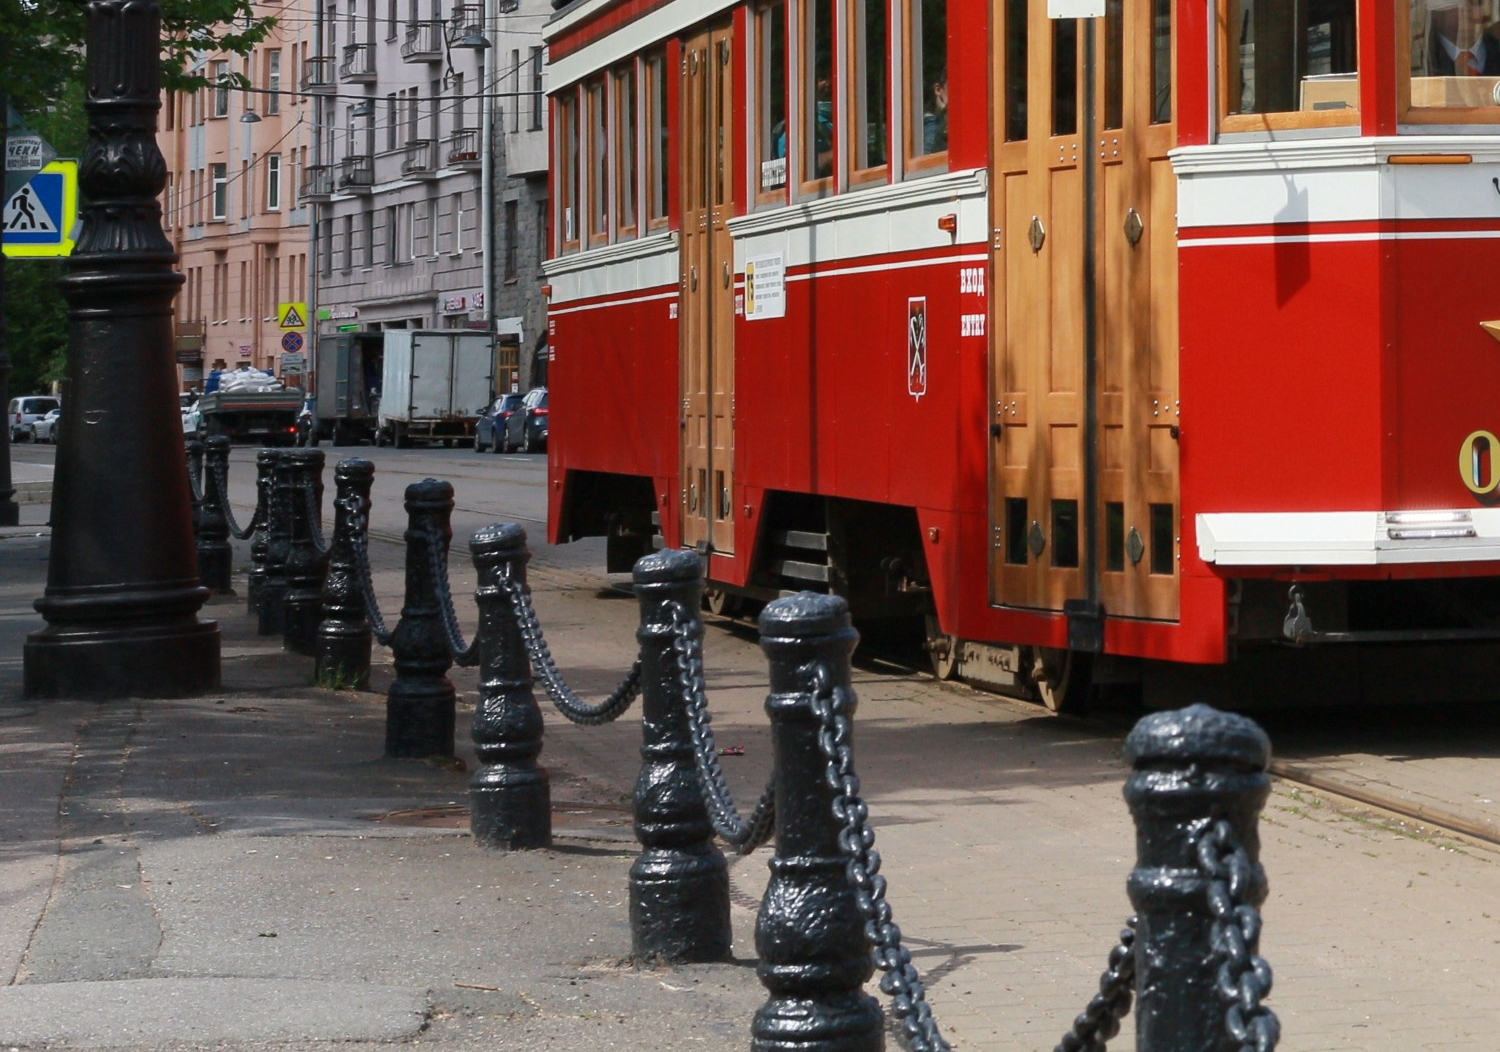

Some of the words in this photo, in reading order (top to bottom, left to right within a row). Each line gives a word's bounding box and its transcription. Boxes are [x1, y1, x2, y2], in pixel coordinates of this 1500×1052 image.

[8, 145, 40, 157] ЧЕКИ
[960, 267, 985, 297] ВХОД
[961, 314, 985, 337] ENTRY
